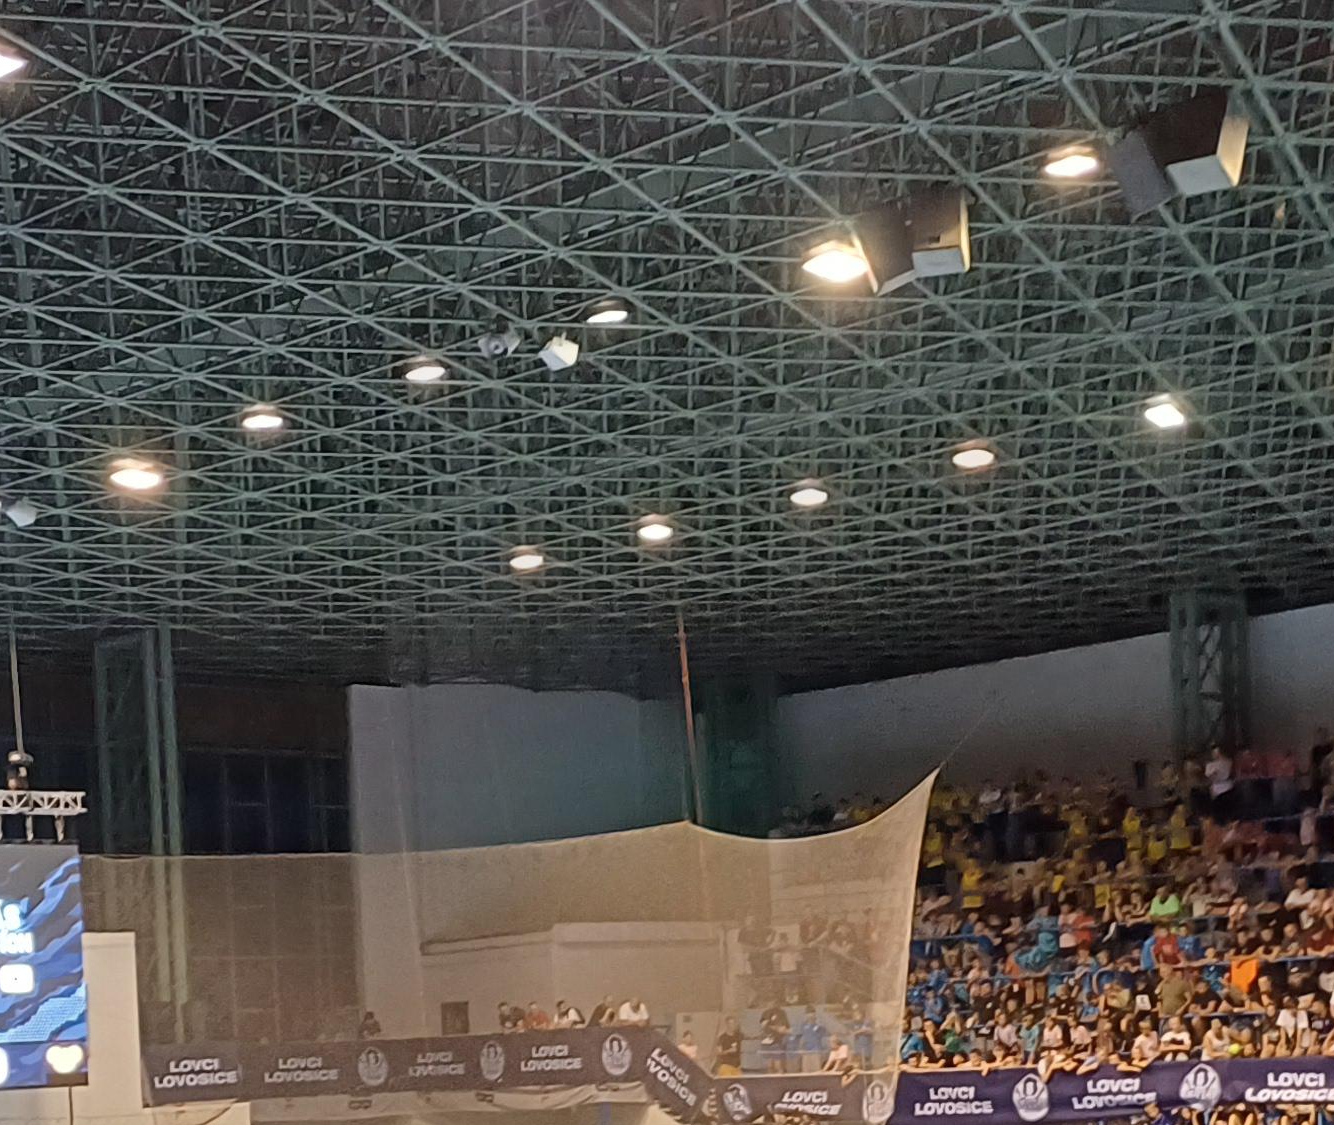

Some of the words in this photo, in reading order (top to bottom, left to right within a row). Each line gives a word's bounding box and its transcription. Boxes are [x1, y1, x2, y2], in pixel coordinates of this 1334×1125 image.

[532, 1045, 568, 1057] LOVCI
[170, 1058, 219, 1072] LOVCI
[278, 1057, 322, 1070] LOVCI
[154, 1070, 238, 1089] LOVOSICE
[264, 1069, 339, 1083] LOVOSICE
[1267, 1072, 1325, 1088] LOVCI
[1087, 1078, 1140, 1093] LOVCI
[782, 1091, 827, 1103] LOVCI
[929, 1086, 975, 1100] LOVCI
[915, 1101, 994, 1116] LOVOSICE
